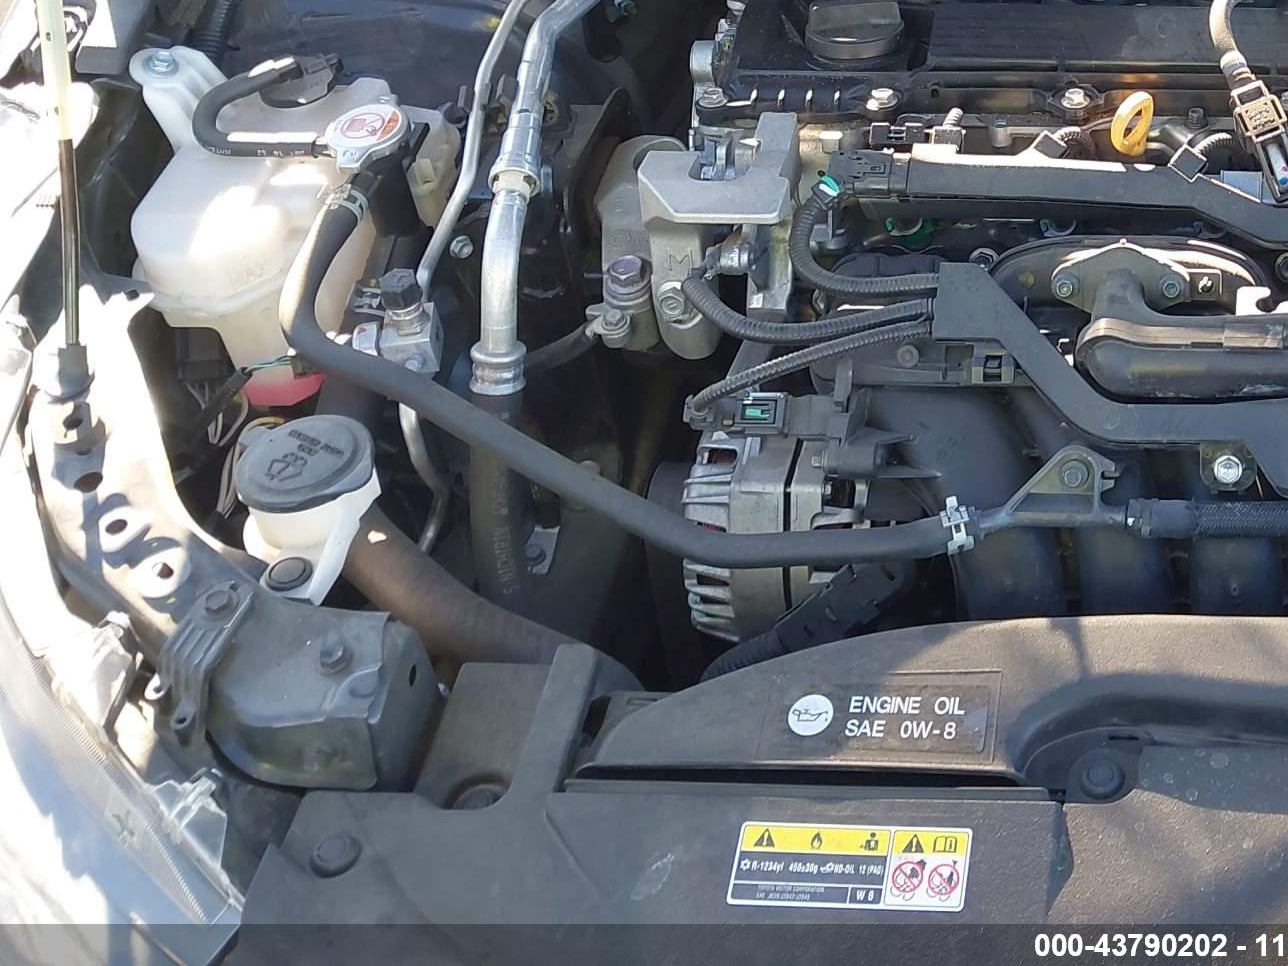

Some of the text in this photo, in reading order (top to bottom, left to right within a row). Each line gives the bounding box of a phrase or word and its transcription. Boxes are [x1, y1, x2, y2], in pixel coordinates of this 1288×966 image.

[848, 695, 966, 715] ENGINE OIL
[844, 719, 957, 740] SAE 0W-8
[856, 889, 867, 901] W
